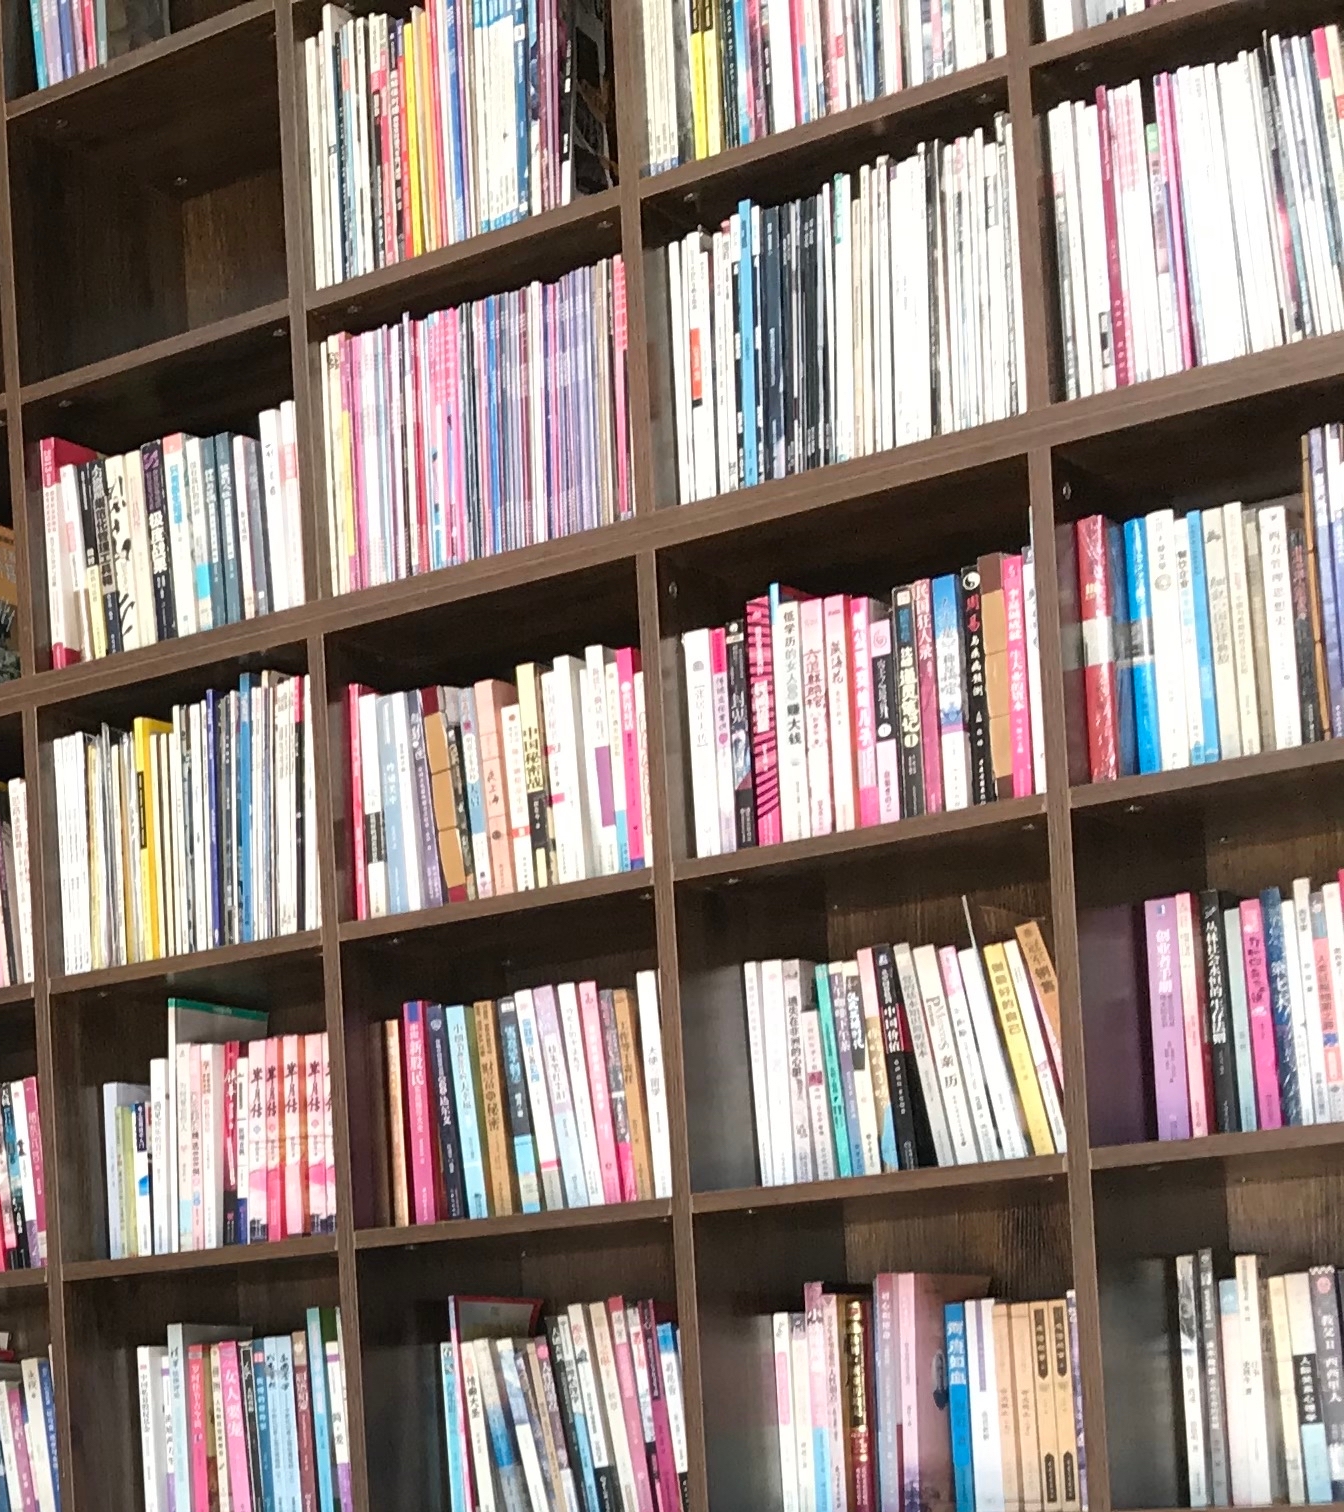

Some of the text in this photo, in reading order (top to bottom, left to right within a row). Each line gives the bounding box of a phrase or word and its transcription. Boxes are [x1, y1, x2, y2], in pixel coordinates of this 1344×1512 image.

[522, 726, 544, 791] 中国秘密战
